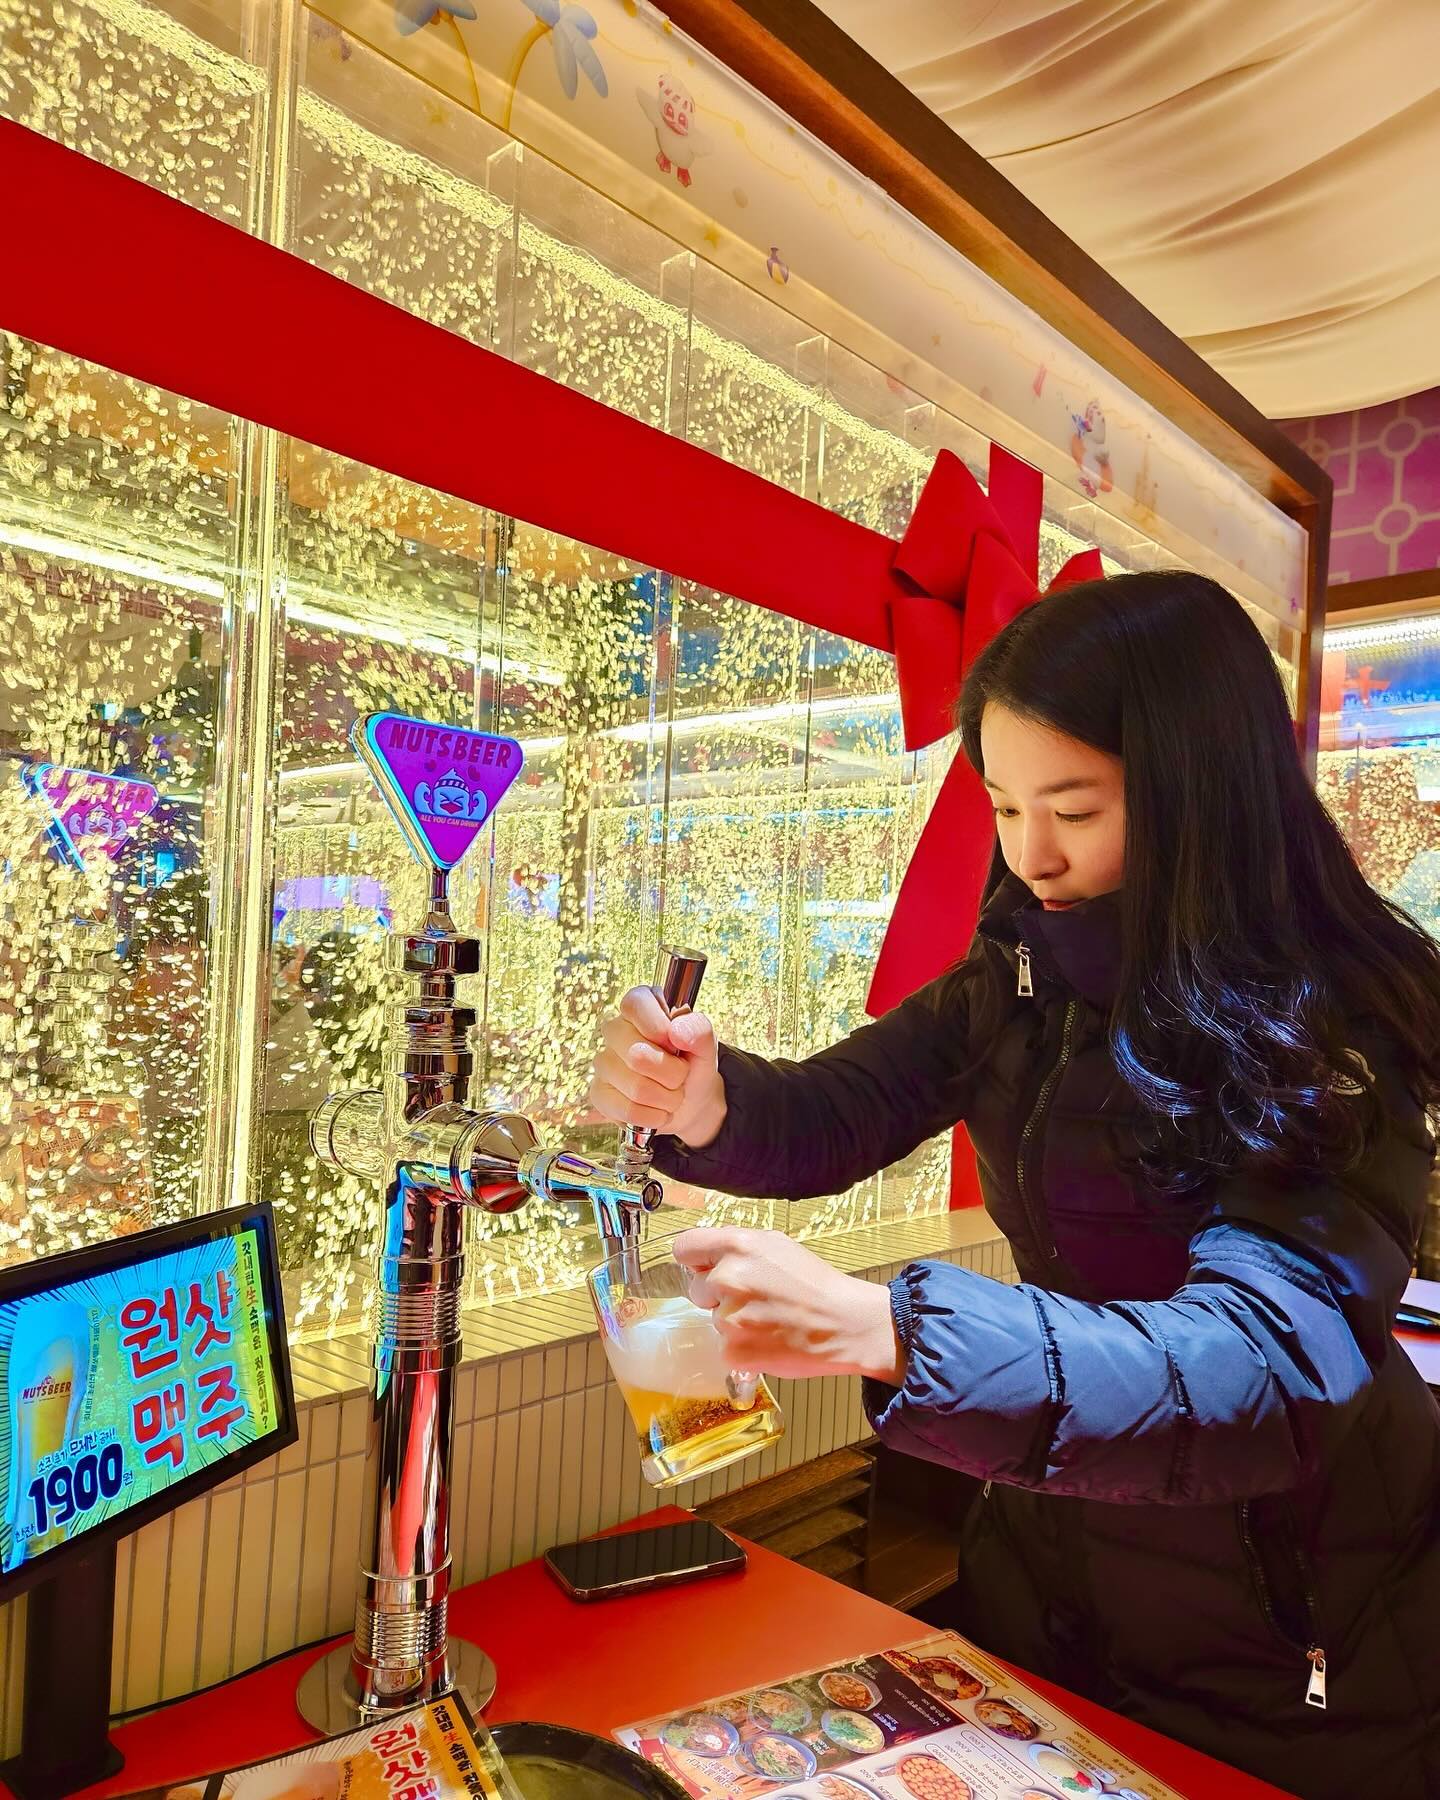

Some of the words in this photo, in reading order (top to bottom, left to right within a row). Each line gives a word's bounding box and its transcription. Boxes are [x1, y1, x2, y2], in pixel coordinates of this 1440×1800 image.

[389, 723, 512, 768] NUTSBEER
[433, 817, 446, 825] YOU
[447, 818, 460, 826] CAN
[121, 1270, 233, 1378] 원샷
[23, 1382, 72, 1400] NUTSBEER
[133, 1366, 245, 1467] 맥주
[69, 1432, 98, 1456] 무제한
